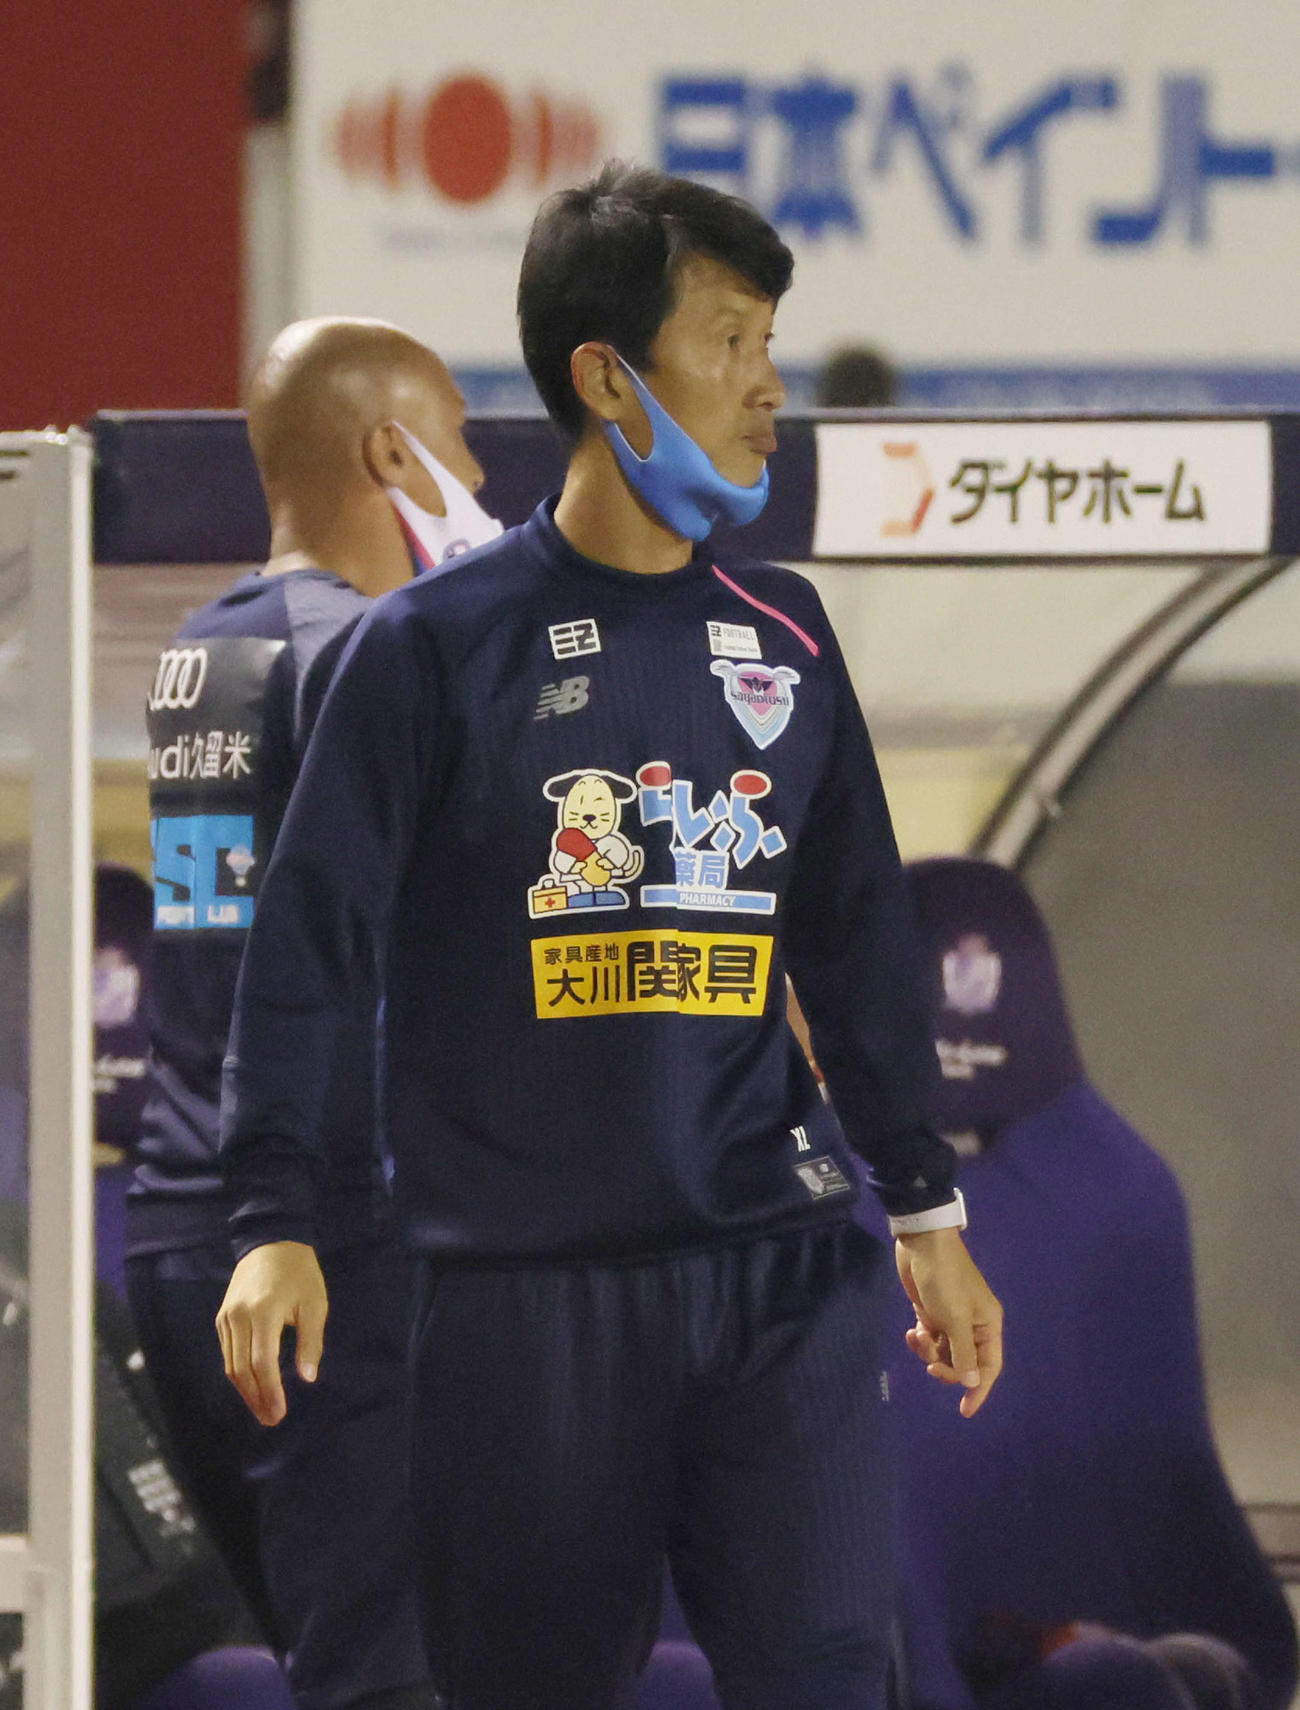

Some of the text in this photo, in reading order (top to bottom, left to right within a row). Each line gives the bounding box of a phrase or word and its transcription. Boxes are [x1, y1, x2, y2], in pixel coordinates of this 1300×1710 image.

[949, 456, 1206, 525] ダイヤホーム
[679, 892, 736, 907] PHARMACY
[544, 943, 619, 965] 家具産地
